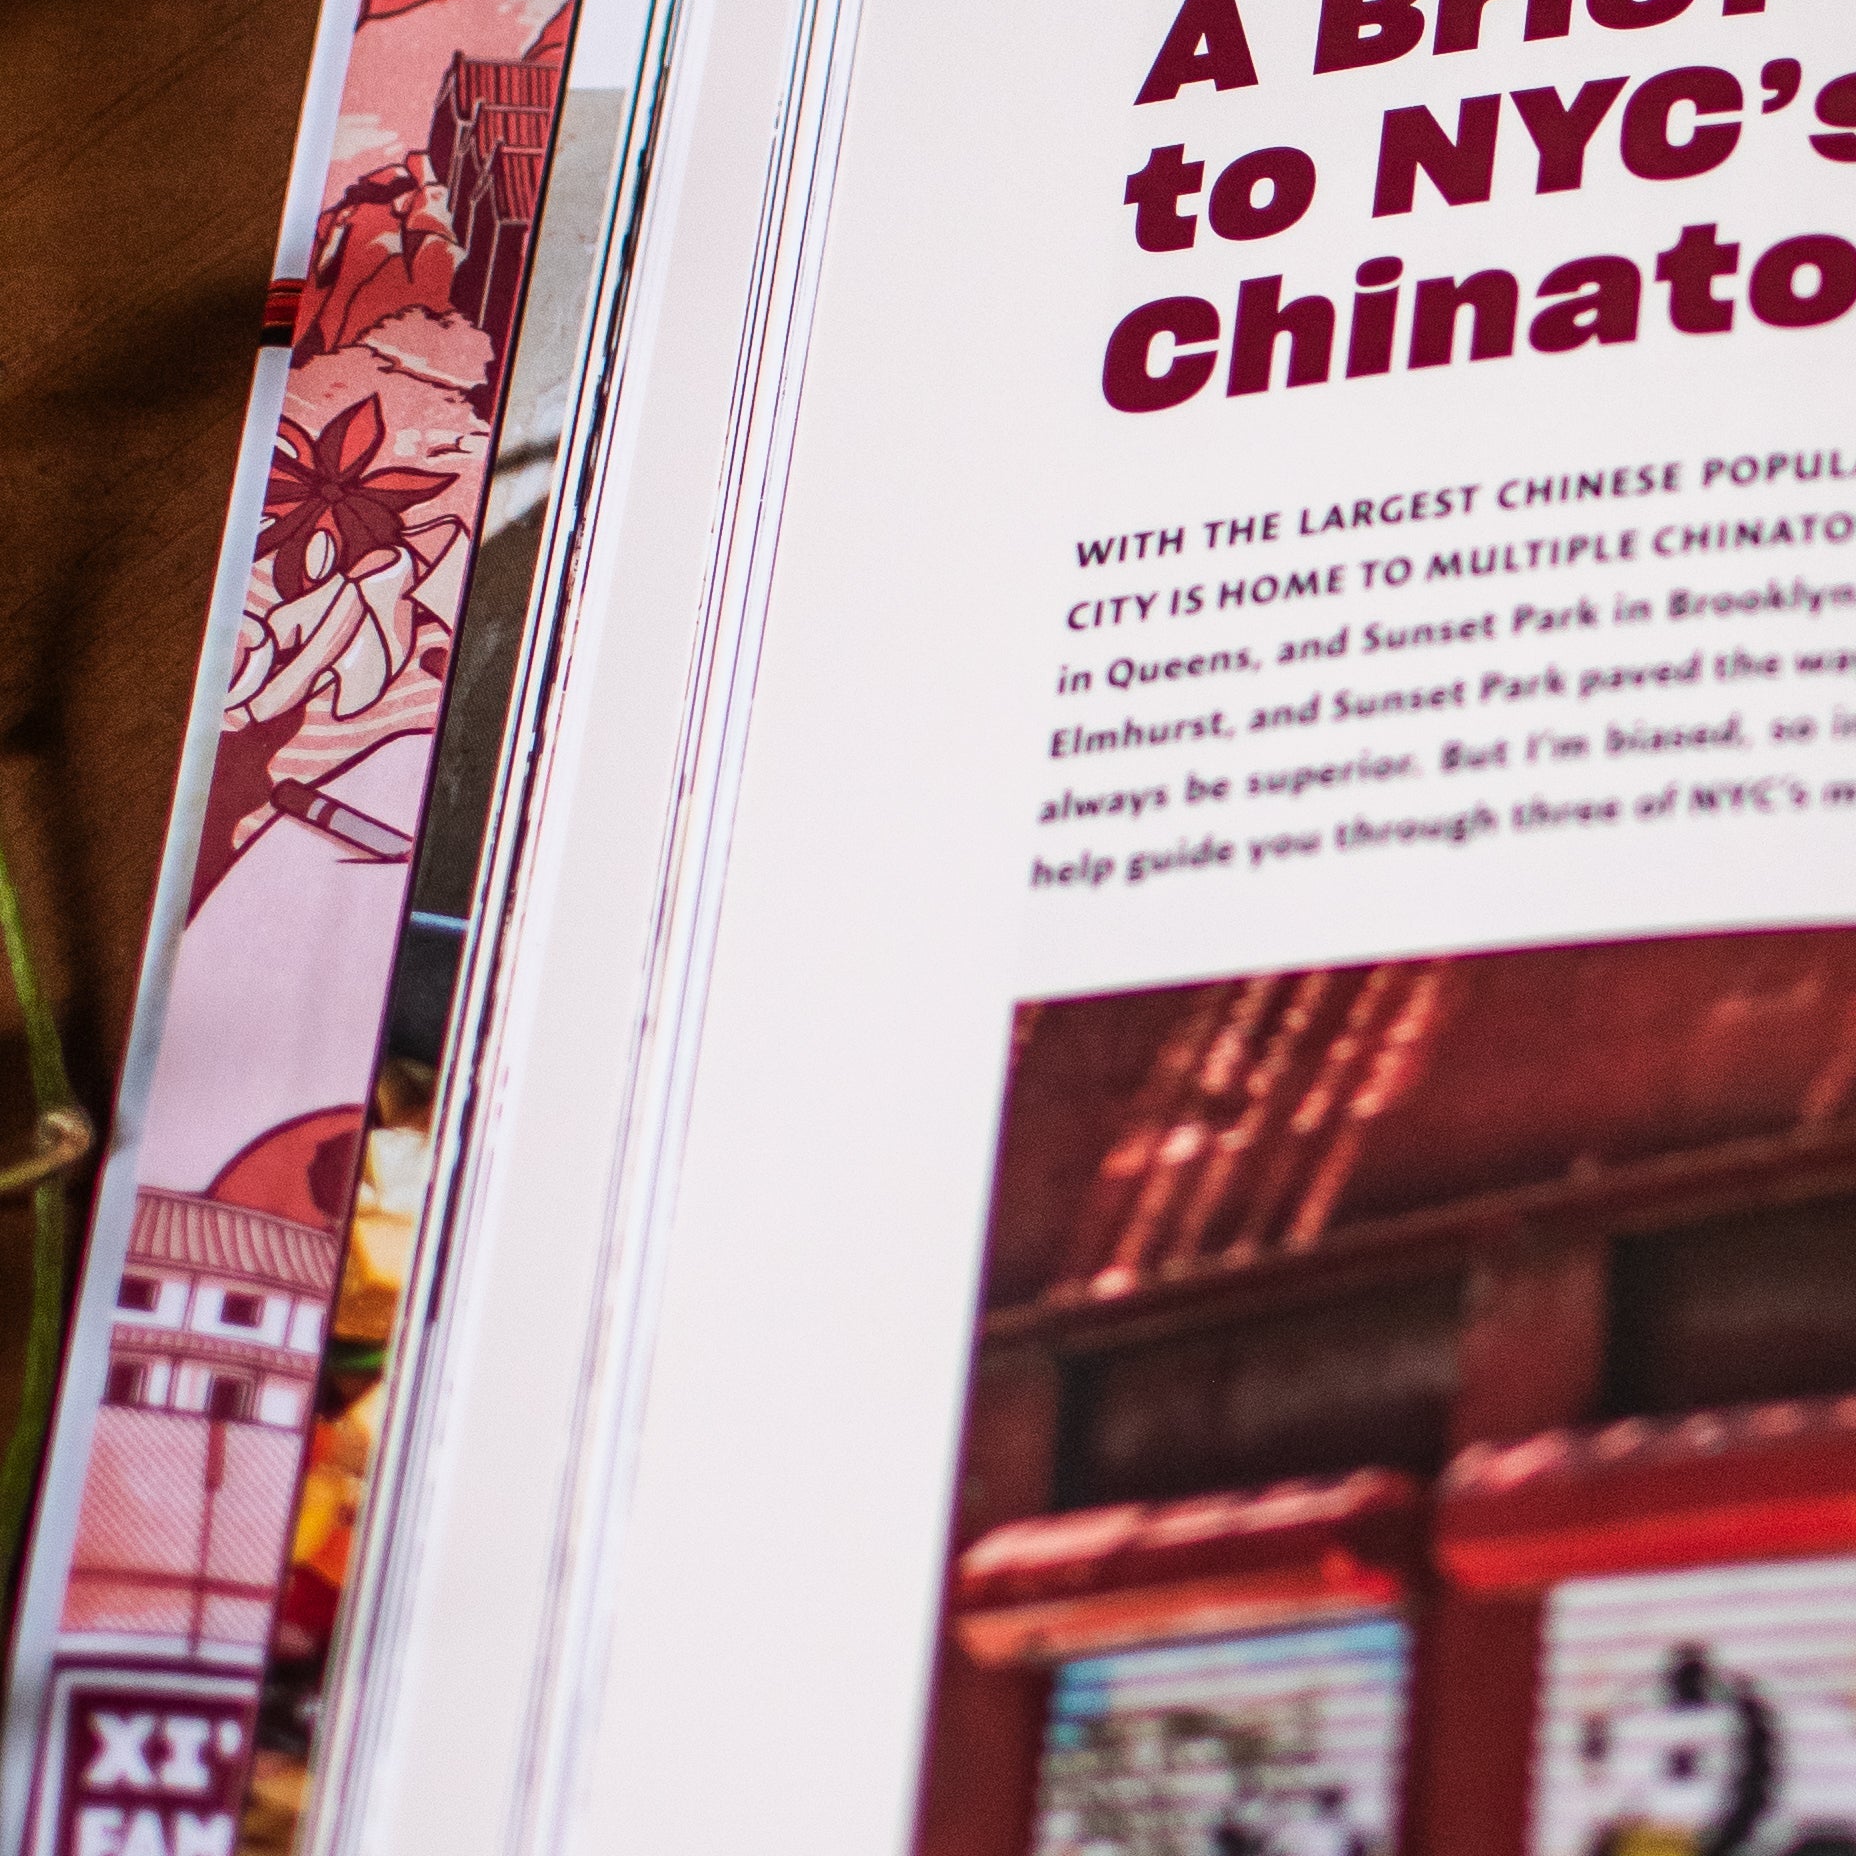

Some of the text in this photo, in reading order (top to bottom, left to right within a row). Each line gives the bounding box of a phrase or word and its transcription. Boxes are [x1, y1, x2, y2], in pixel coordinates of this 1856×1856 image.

[1123, 143, 1317, 253] to
[1076, 527, 1185, 569] WITH
[1205, 512, 1279, 549] THE
[1299, 485, 1477, 536] LARGEST
[1496, 464, 1677, 510] CHINESE
[1066, 593, 1157, 632] CITY
[1169, 585, 1204, 616] IS
[1218, 565, 1342, 609] HOME
[1362, 557, 1413, 588] TO
[1426, 531, 1634, 579] MULTIPLE
